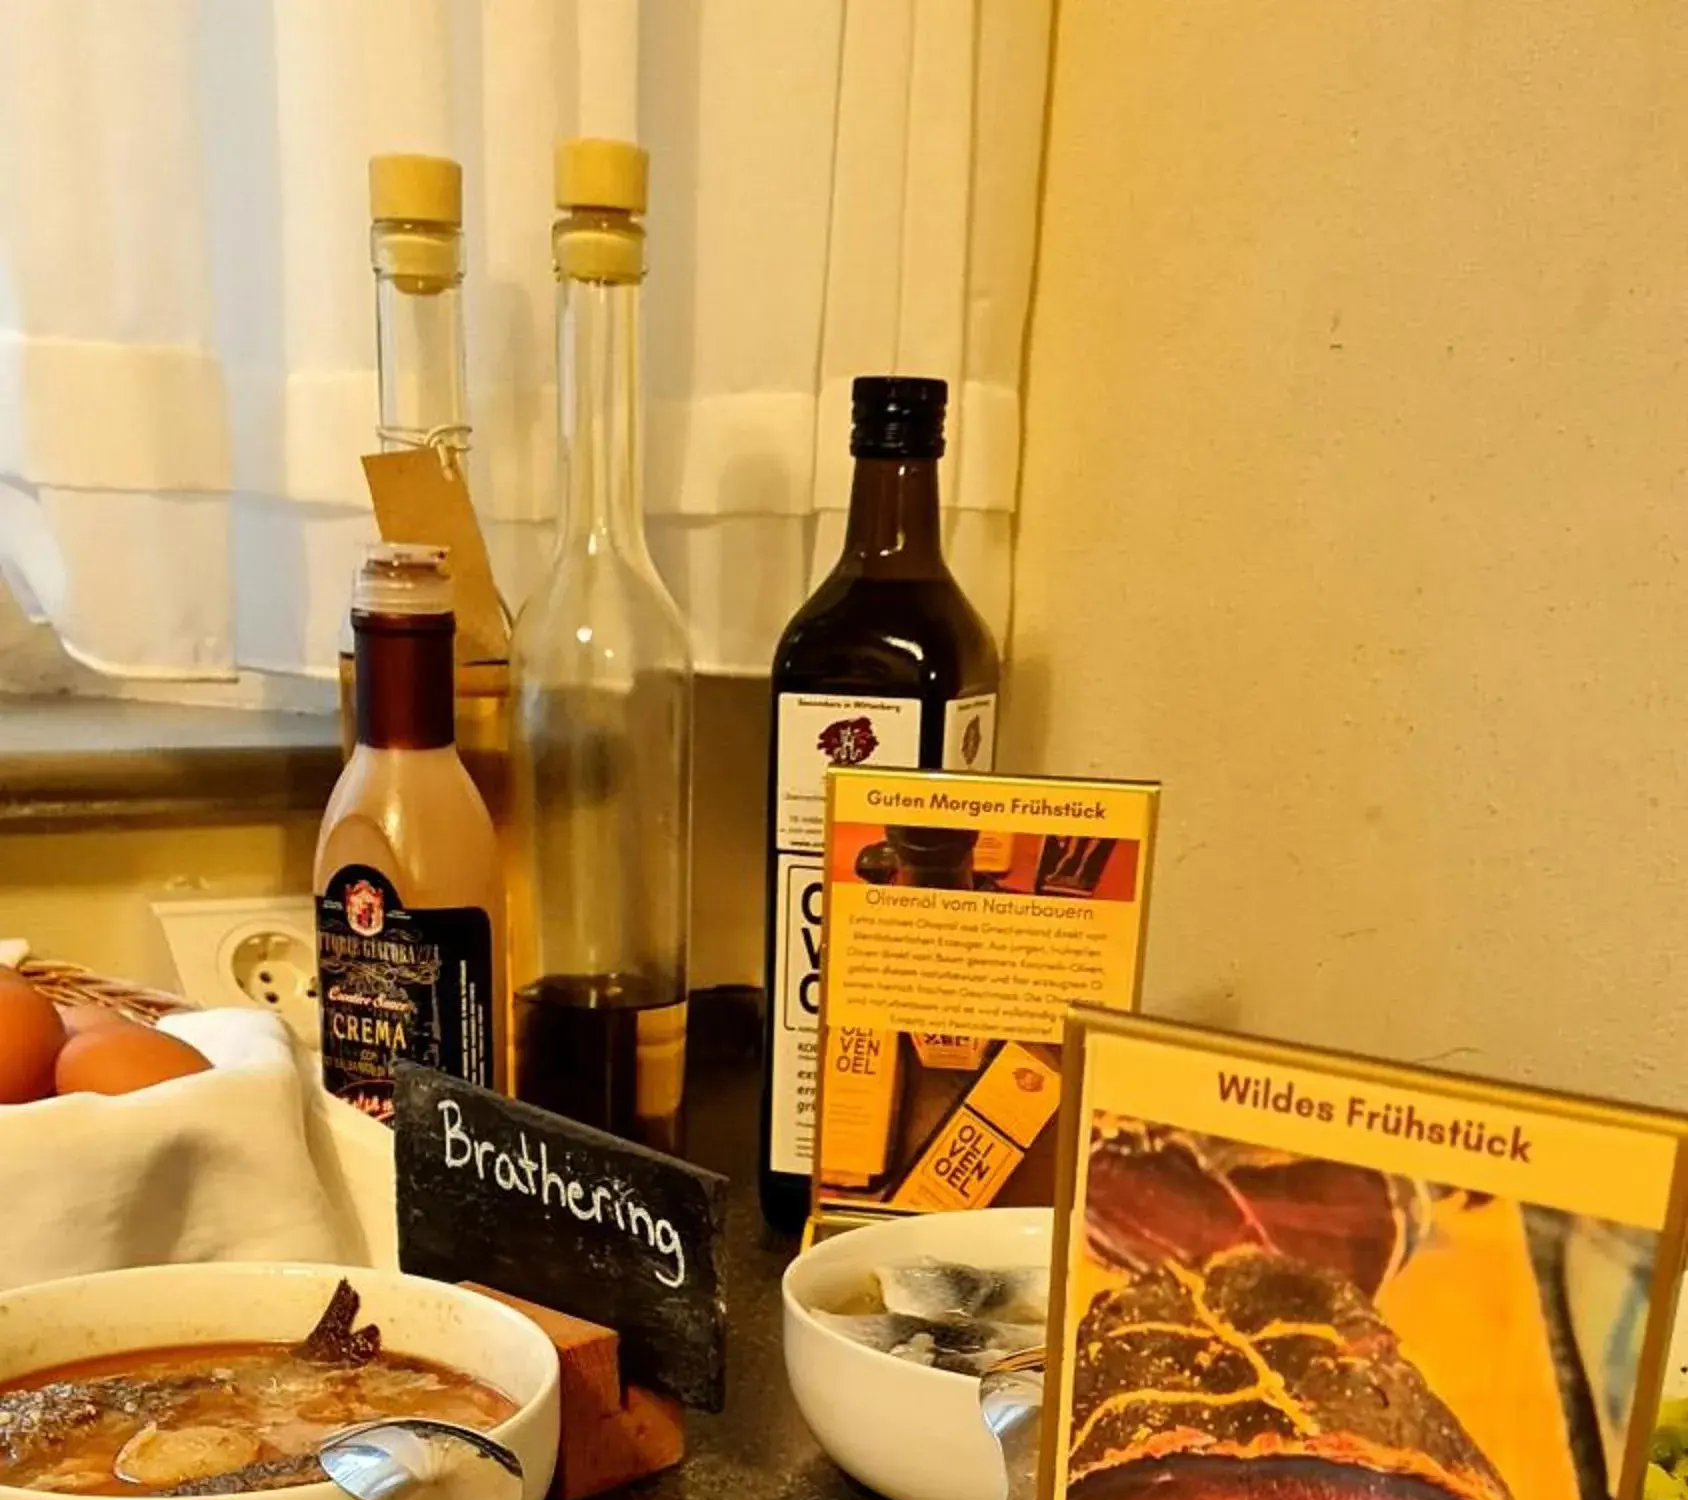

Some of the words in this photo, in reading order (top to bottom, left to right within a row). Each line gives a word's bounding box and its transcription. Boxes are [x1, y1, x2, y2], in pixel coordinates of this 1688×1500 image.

[867, 789, 925, 810] Guten
[929, 793, 1005, 816] Morgen
[1010, 798, 1107, 820] Frühstück
[865, 889, 937, 910] Olivenöl
[942, 897, 977, 913] vom
[983, 898, 1094, 921] Naturbauern
[332, 1013, 408, 1050] CREMA
[840, 1037, 881, 1056] VEN
[836, 1055, 877, 1075] OEL
[1217, 1070, 1335, 1123] Wildes
[1346, 1096, 1533, 1164] Frühstück
[957, 1124, 995, 1159] OLI
[934, 1156, 972, 1199] OEL
[948, 1138, 991, 1182] VEN
[437, 1100, 685, 1288] Brathering
